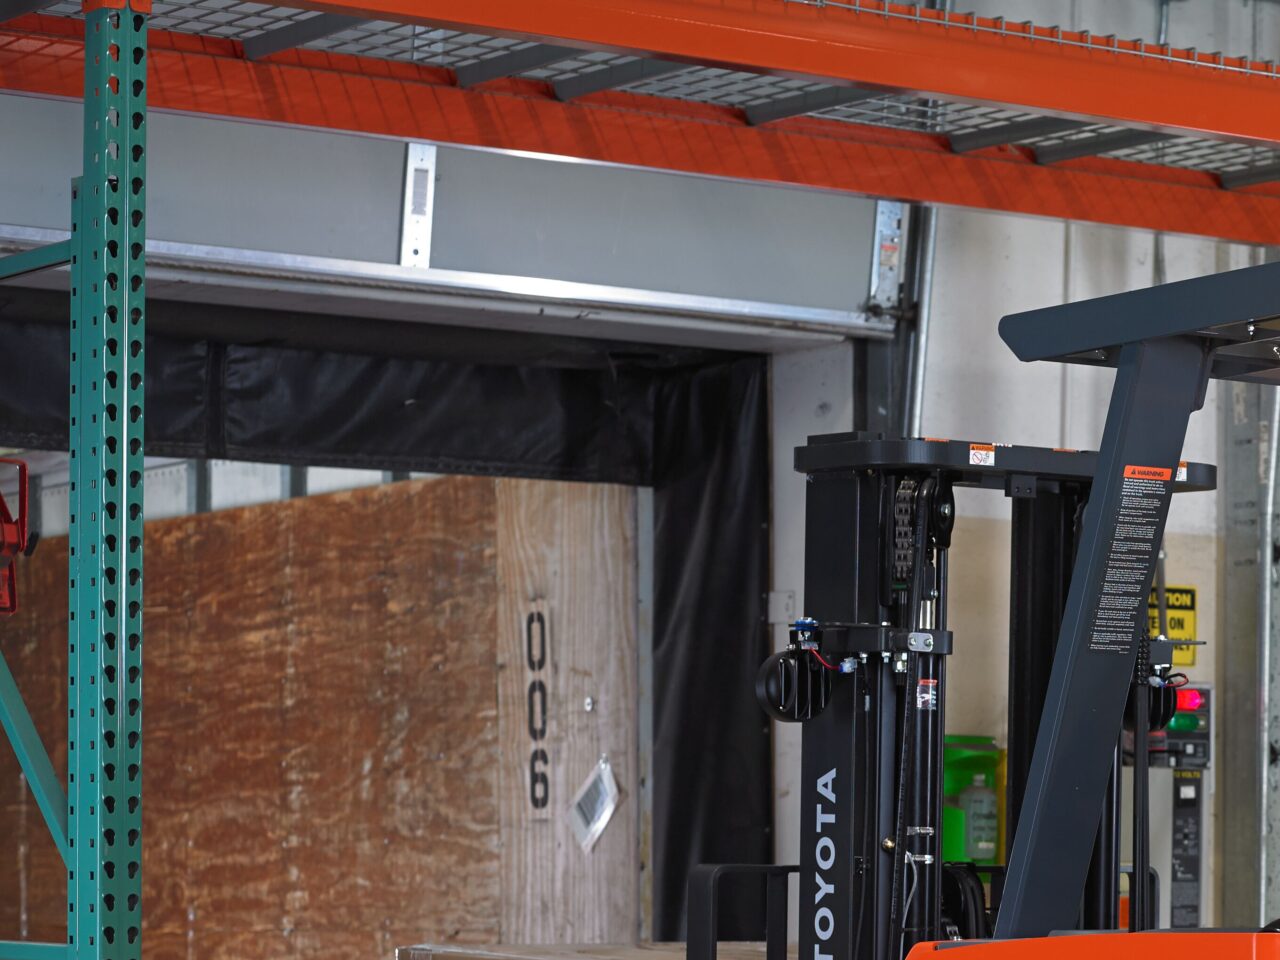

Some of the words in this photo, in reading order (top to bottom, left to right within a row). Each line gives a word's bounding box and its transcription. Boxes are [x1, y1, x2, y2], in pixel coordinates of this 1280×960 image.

[1137, 470, 1165, 478] WARNING
[1169, 617, 1185, 630] ON
[526, 610, 549, 809] 006
